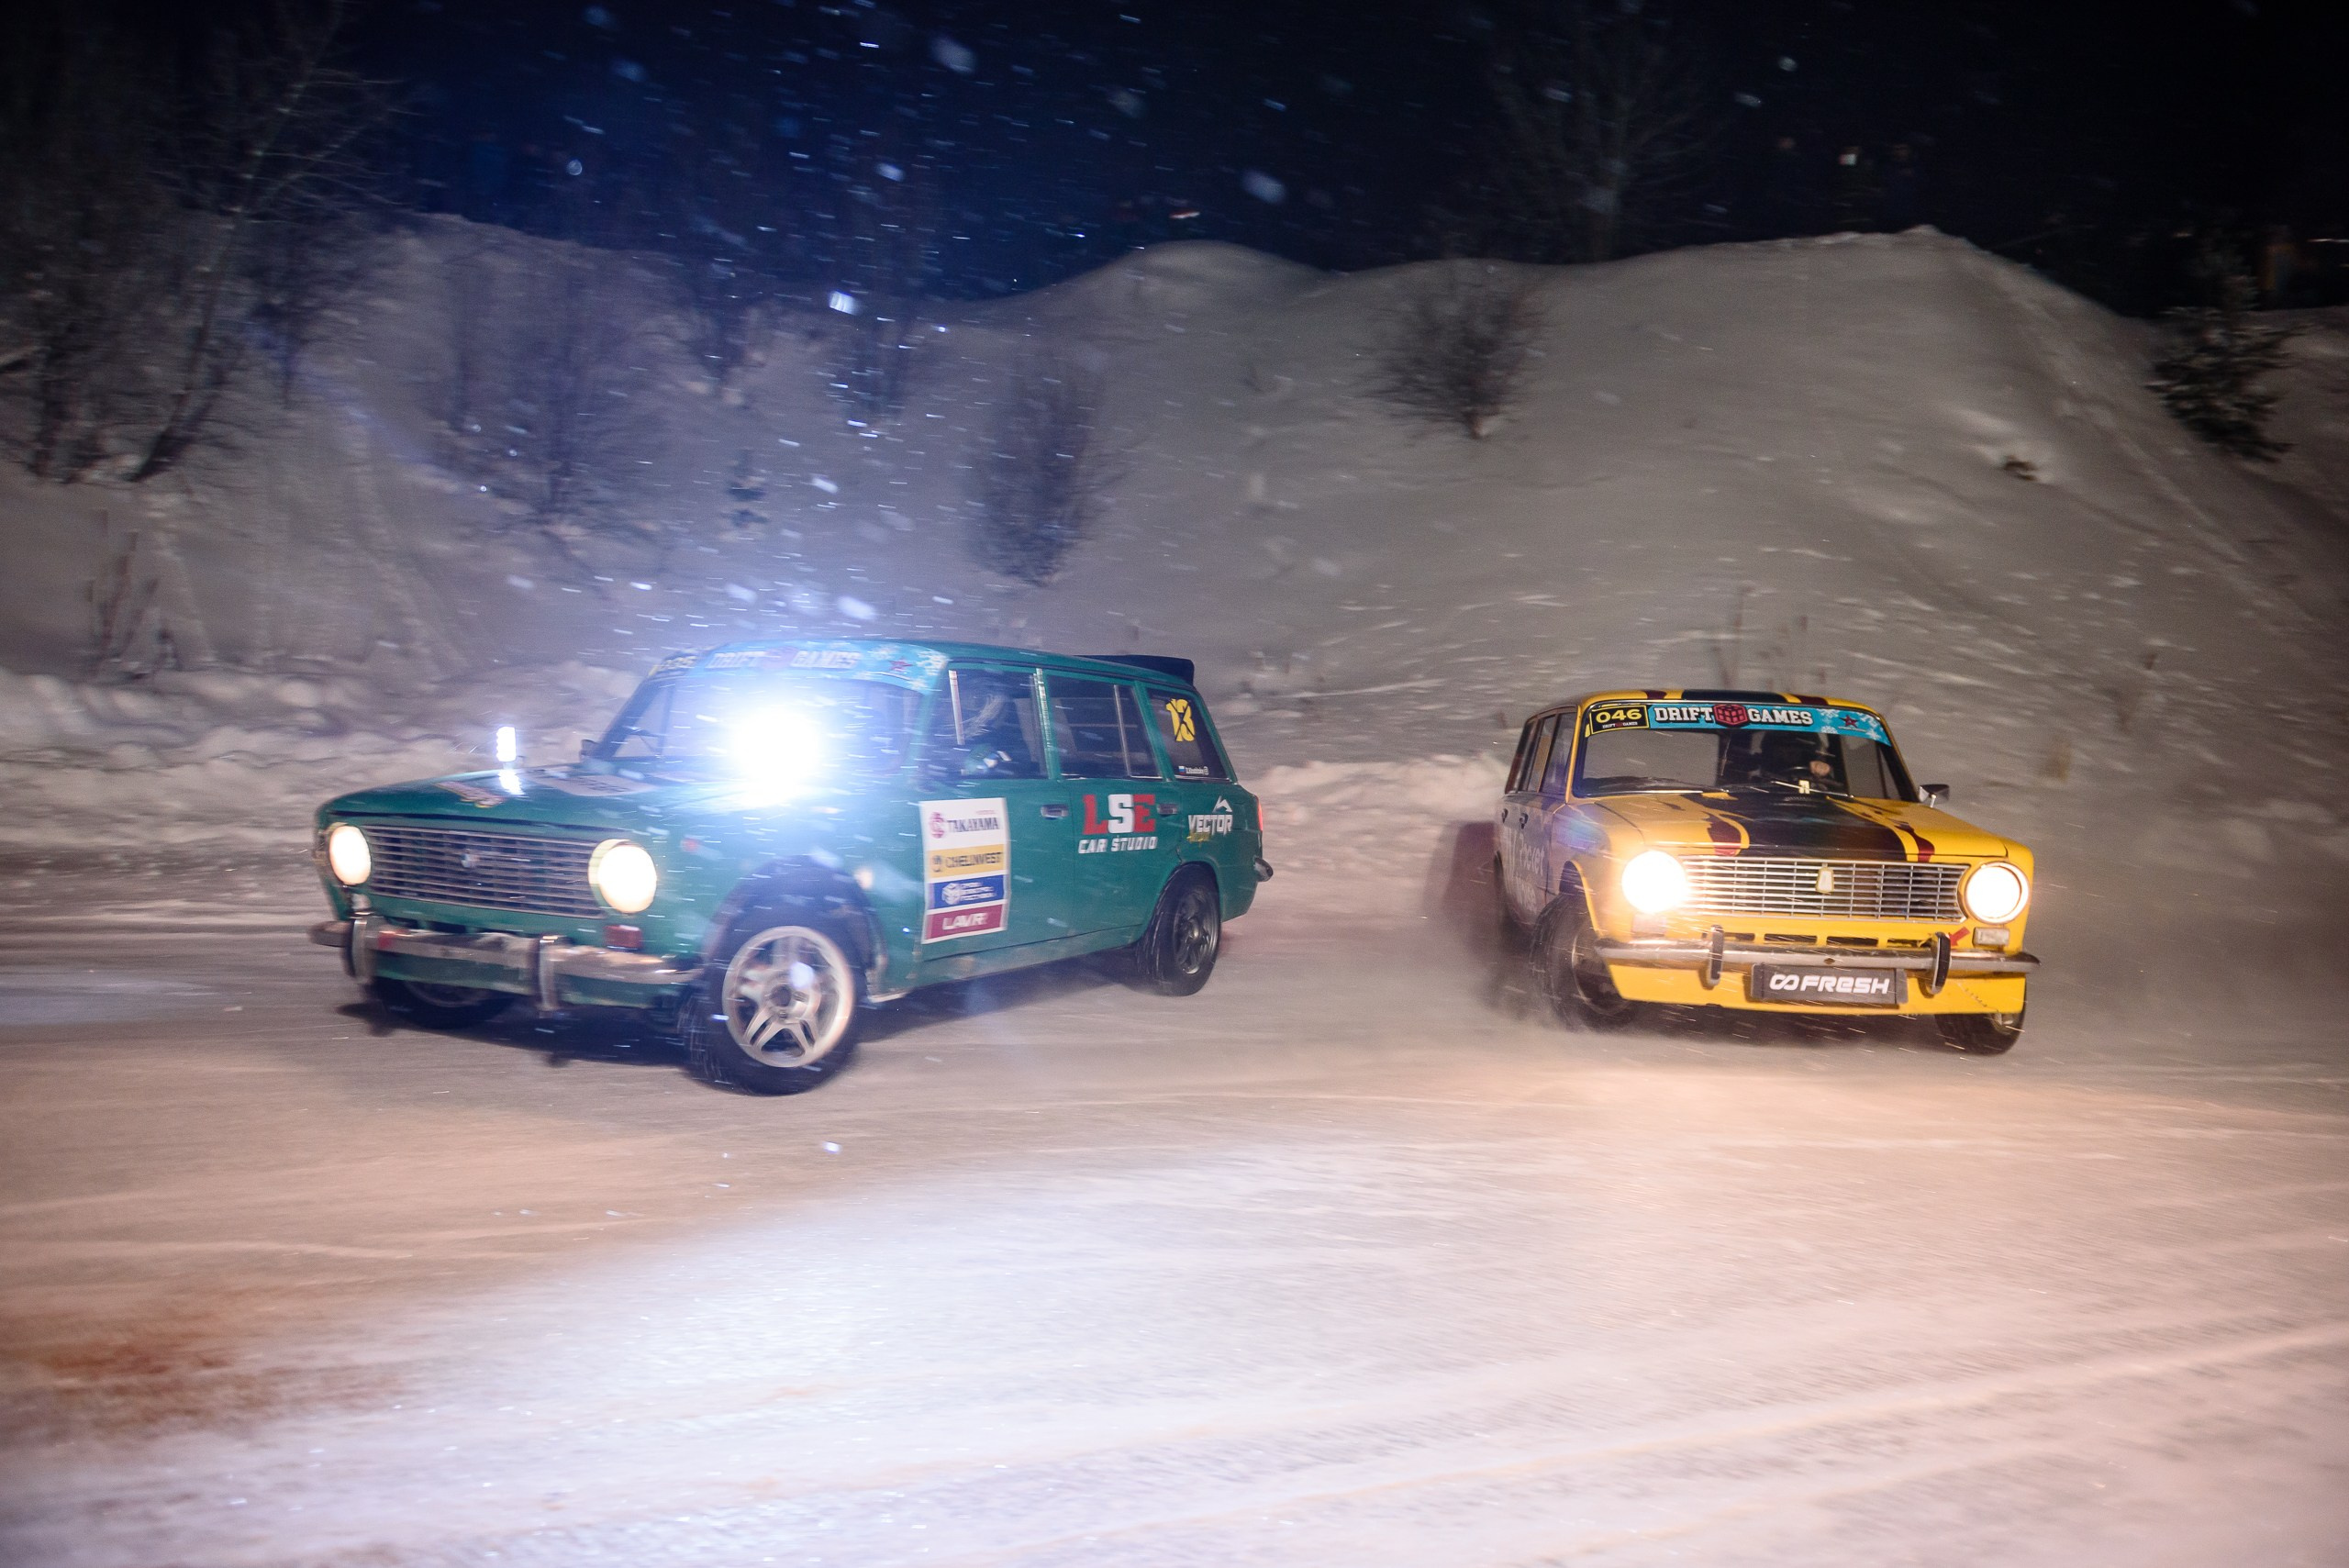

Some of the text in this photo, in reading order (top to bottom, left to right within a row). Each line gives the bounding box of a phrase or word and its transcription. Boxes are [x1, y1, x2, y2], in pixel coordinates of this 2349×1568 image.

[792, 651, 861, 669] GAMES
[1596, 708, 1642, 723] 046
[1654, 706, 1814, 726] DRIFT GAMES
[1083, 794, 1155, 835] LSE
[947, 817, 999, 832] TAKAYAMA
[1187, 814, 1233, 837] VECTOR
[1077, 836, 1158, 854] CAR STUDIO
